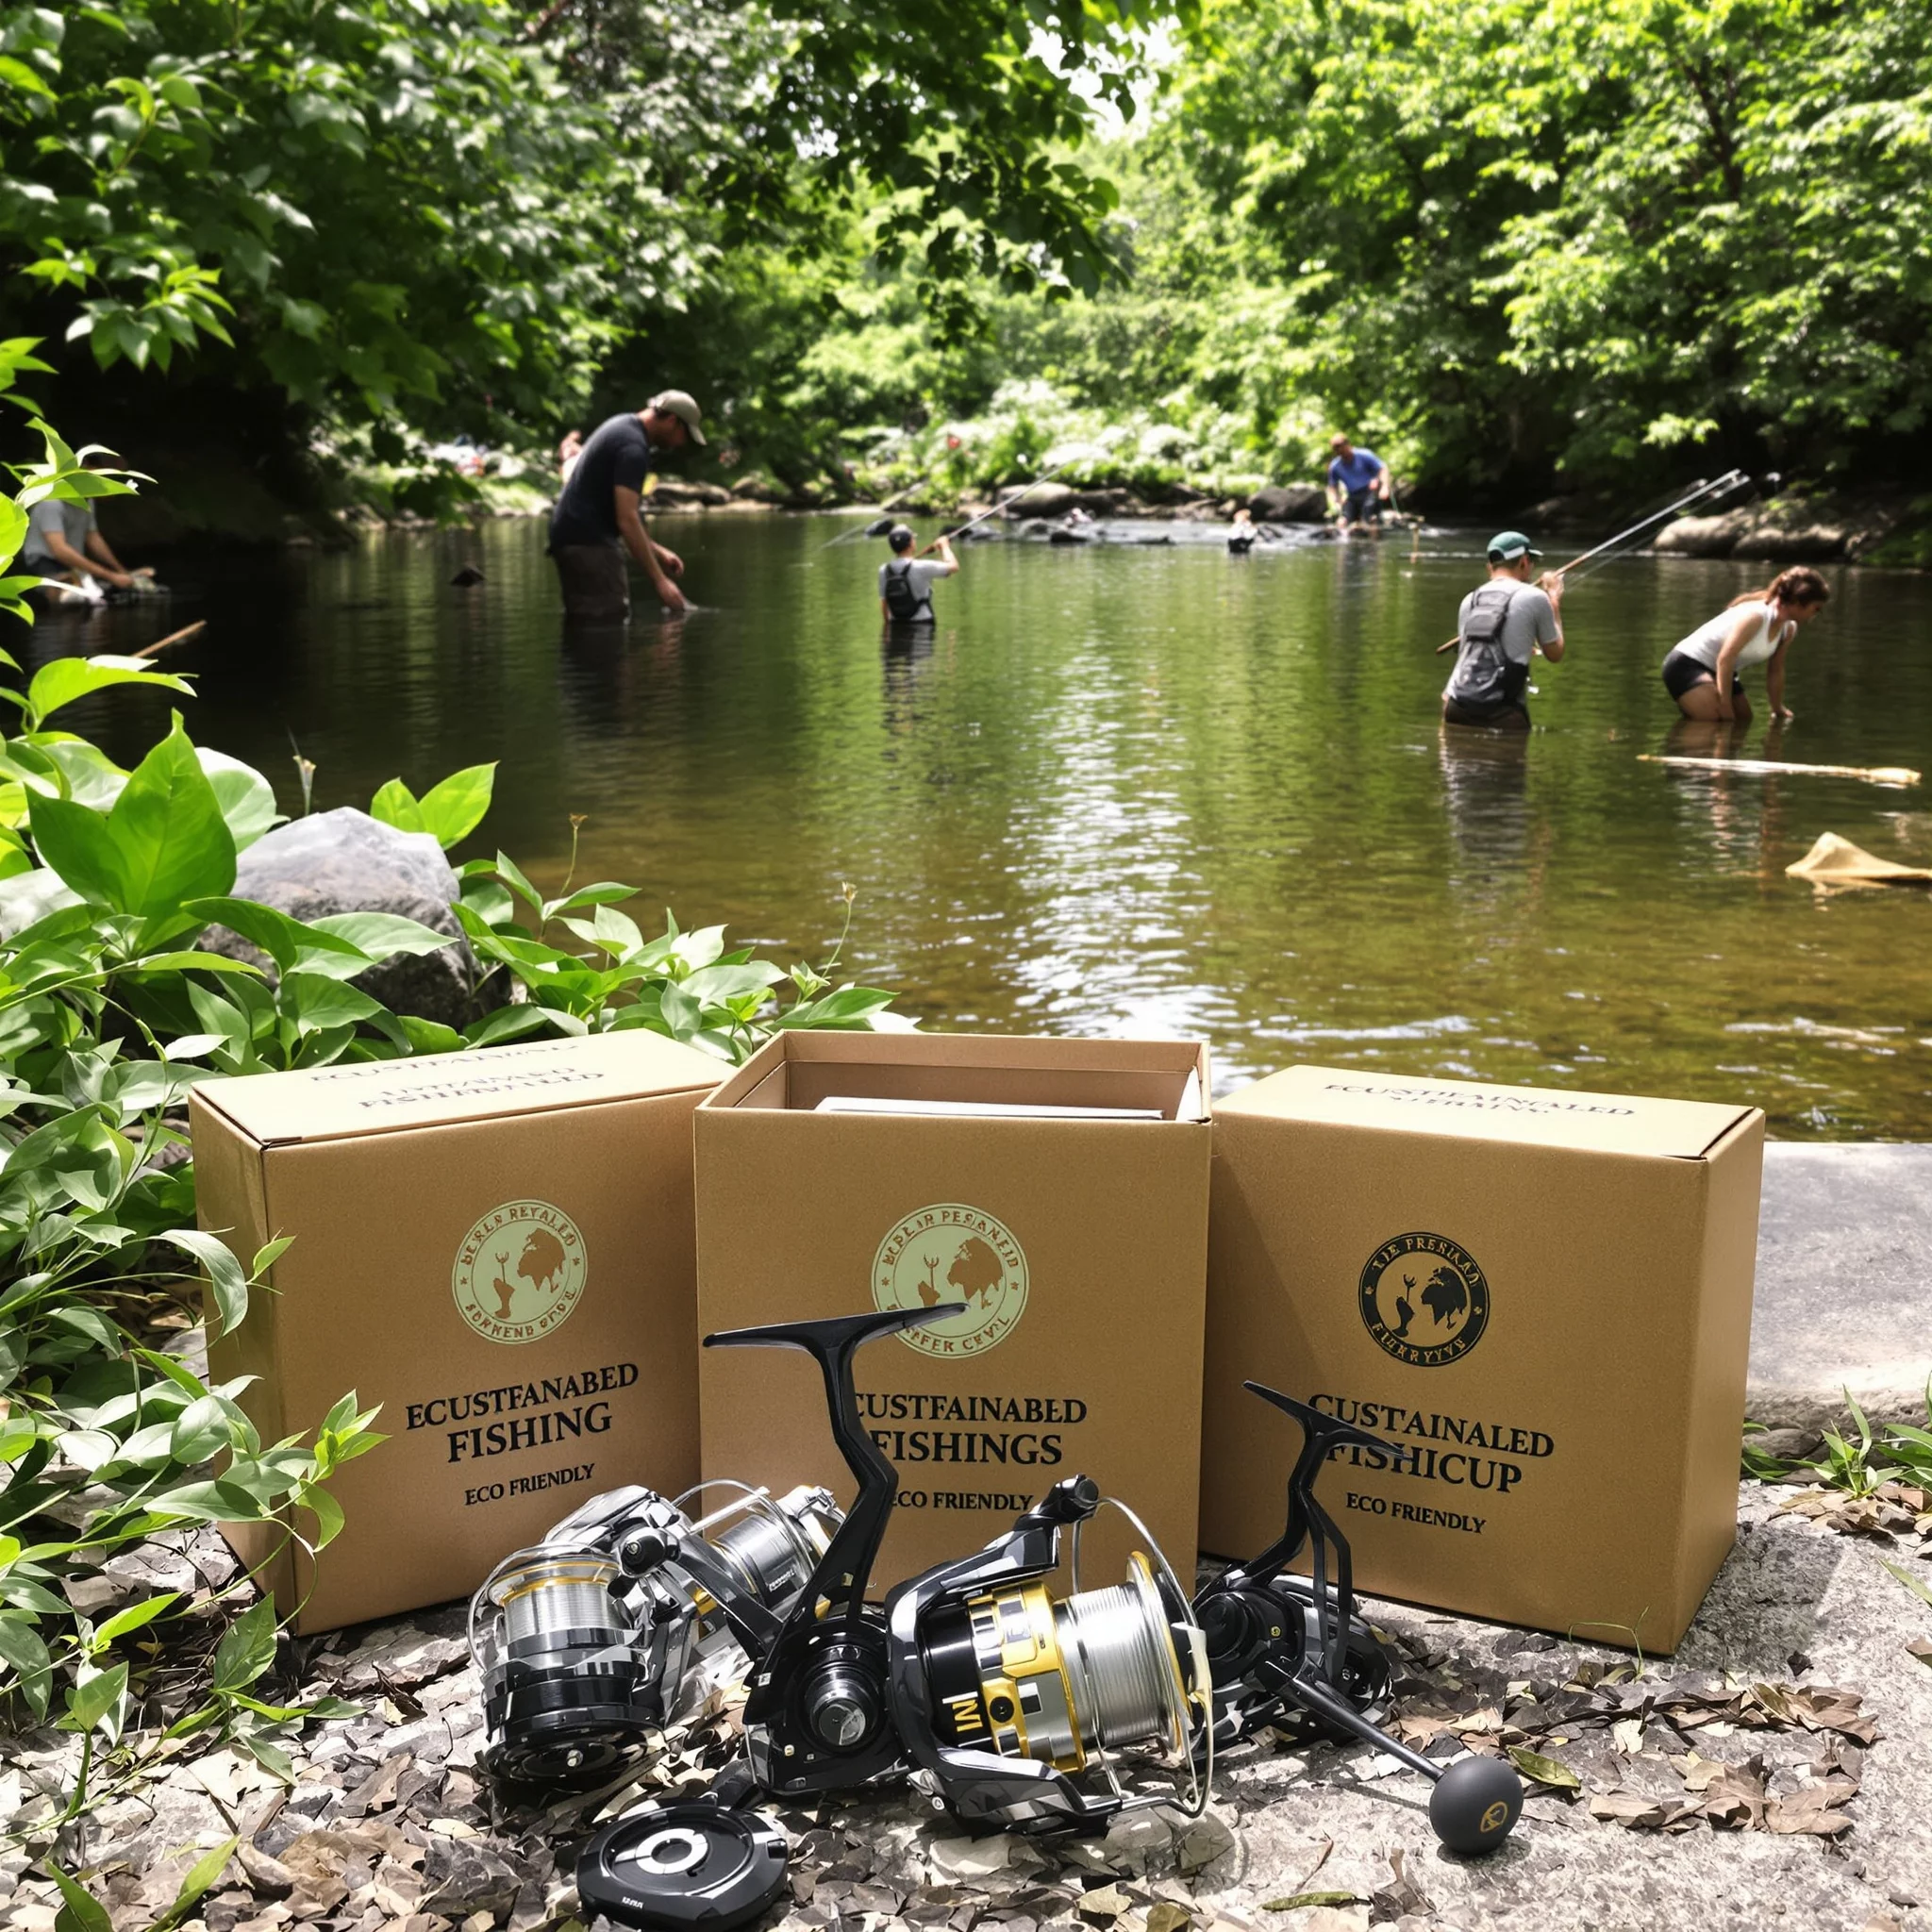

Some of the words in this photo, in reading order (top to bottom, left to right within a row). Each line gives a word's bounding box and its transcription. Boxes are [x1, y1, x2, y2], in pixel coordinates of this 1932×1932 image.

[406, 1363, 639, 1430] ECUSTFANABED
[447, 1402, 612, 1463] FISHING
[869, 1430, 1063, 1464] FISHINGS
[1308, 1393, 1555, 1458] CUSTAINALED
[465, 1483, 505, 1506] ECO
[509, 1463, 594, 1496] FRIENDLY
[892, 1490, 928, 1507] CO
[933, 1491, 1034, 1511] FRIENDLY
[1345, 1491, 1387, 1515] ECO
[1391, 1501, 1487, 1534] FRIENDLY
